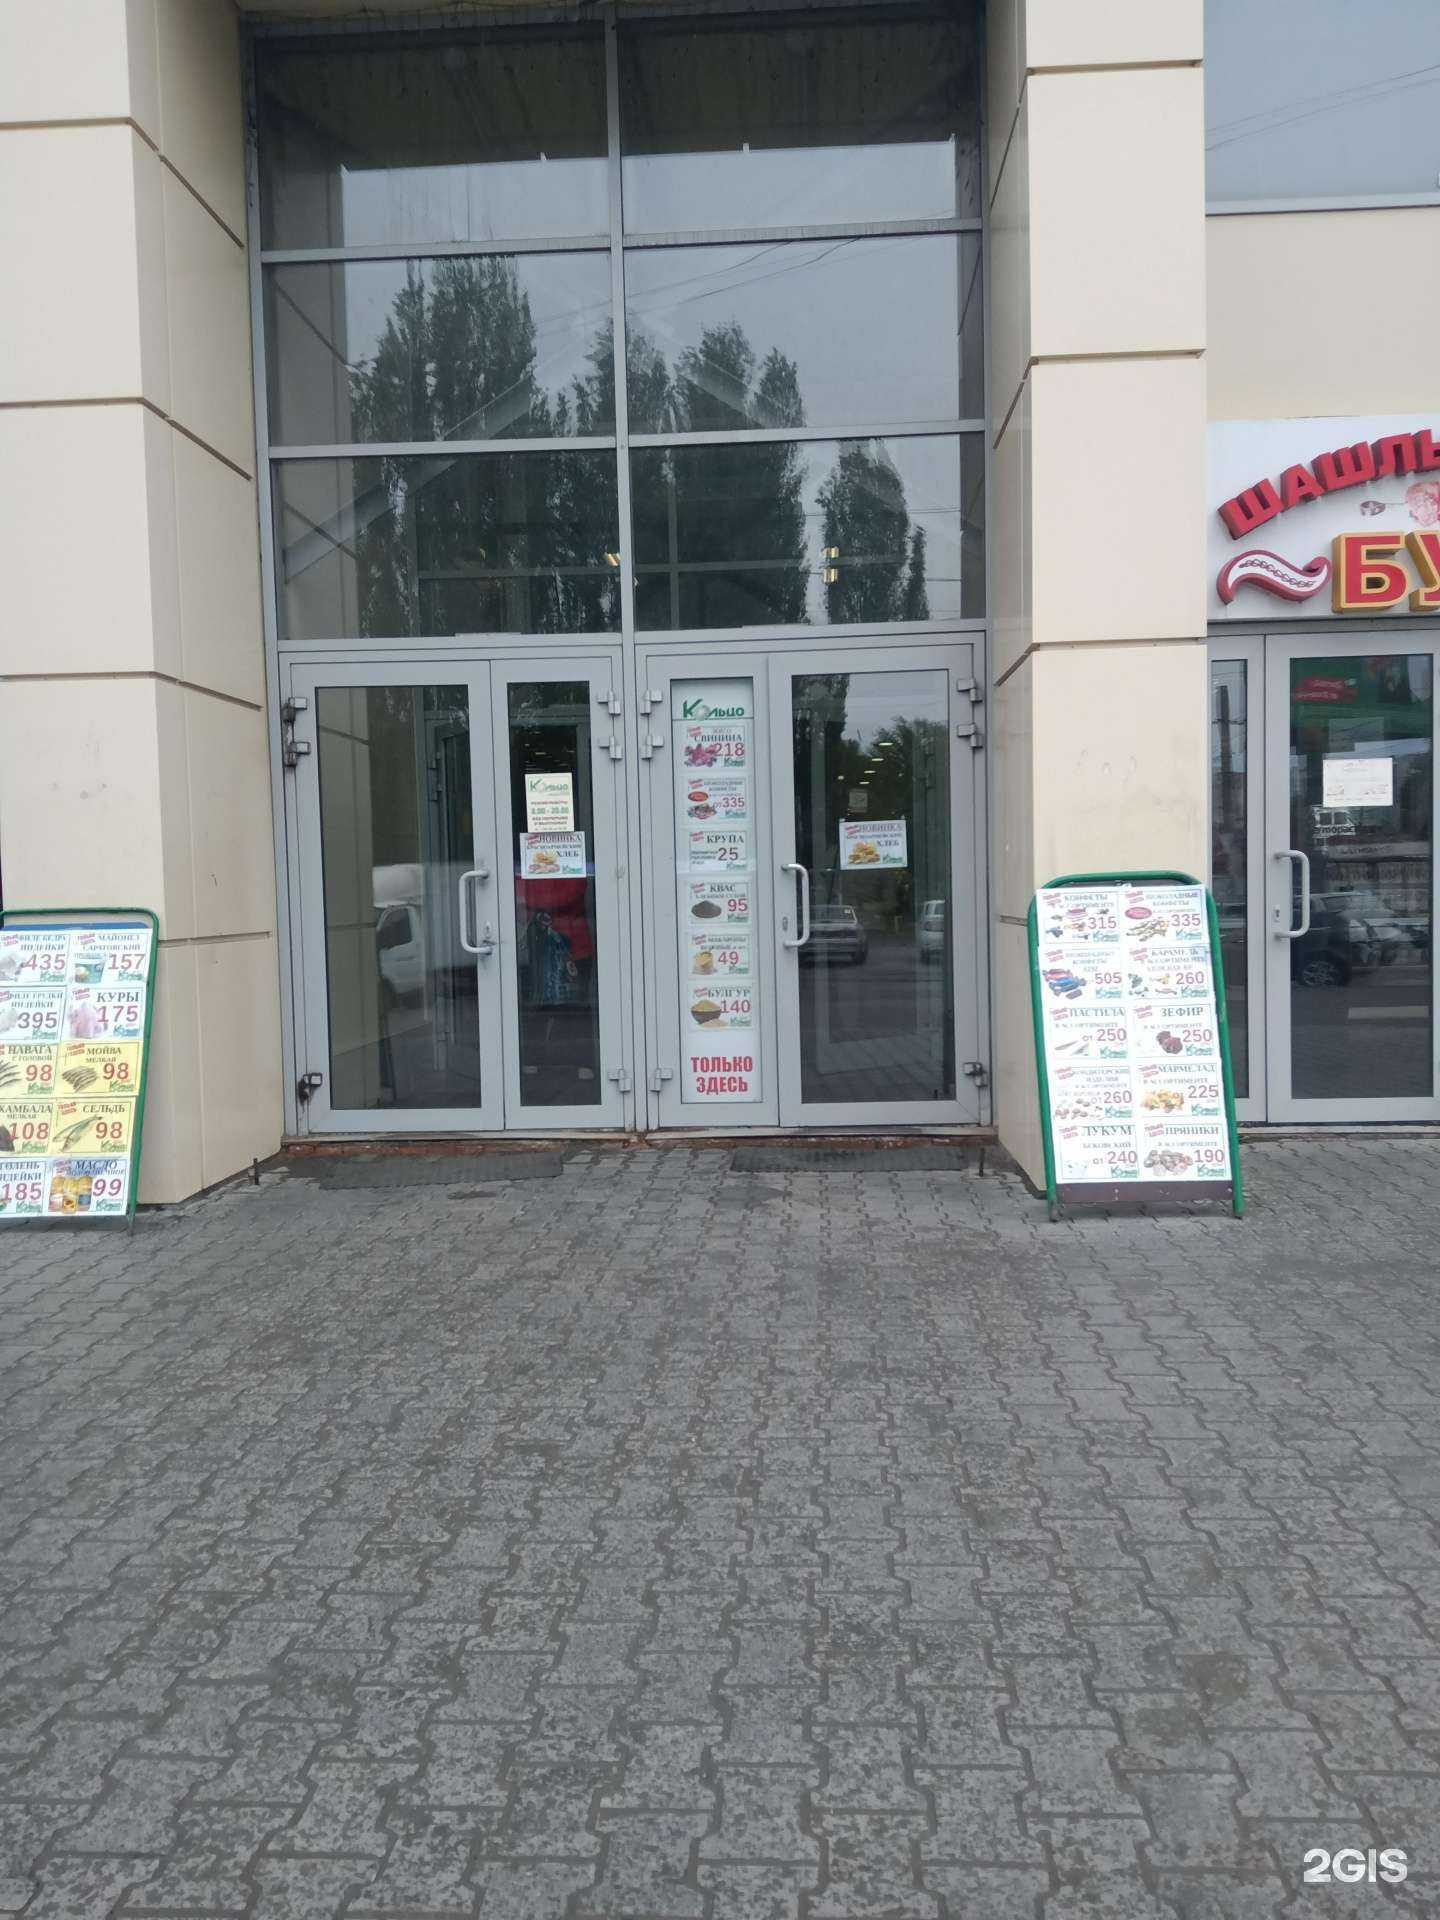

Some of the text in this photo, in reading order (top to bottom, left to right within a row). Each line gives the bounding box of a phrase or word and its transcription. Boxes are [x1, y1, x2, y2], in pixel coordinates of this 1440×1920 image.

[714, 743, 745, 757] 218
[722, 797, 745, 808] 335
[707, 835, 744, 844] КРУПА
[718, 847, 739, 861] 25
[727, 898, 748, 912] 95
[1088, 916, 1116, 929] 315
[1171, 914, 1200, 926] 335
[24, 954, 66, 971] 435
[108, 954, 145, 970] 157
[718, 951, 739, 965] 49
[1095, 972, 1122, 984] 505
[1176, 971, 1204, 984] 260
[97, 992, 140, 1003] КУРЫ
[708, 988, 750, 997] БУЛГУР
[720, 1000, 751, 1013] 140
[1161, 1007, 1203, 1017] ЗЕФИР
[18, 1012, 58, 1029] 395
[97, 1005, 139, 1023] 175
[1097, 1028, 1127, 1041] 250
[1183, 1029, 1213, 1042] 250
[8, 1044, 52, 1055] НАВАГА
[86, 1046, 122, 1055] МОЙВА
[103, 1062, 129, 1080] 98
[690, 1056, 753, 1073] ТОЛЬКО
[26, 1064, 52, 1081] 98
[696, 1076, 748, 1095] ЗДЕСЬ
[1188, 1085, 1219, 1099] 225
[1104, 1090, 1132, 1104] 260
[83, 1104, 125, 1113] СЕЛЬДЬ
[9, 1122, 49, 1141] 108
[96, 1121, 122, 1139] 98
[1082, 1126, 1132, 1136] ЛУКУМ
[1166, 1127, 1219, 1135] ПРЯНИКИ
[1107, 1151, 1137, 1164] 240
[1194, 1149, 1225, 1163] 190
[75, 1160, 117, 1169] МАСЛО
[2, 1182, 41, 1201] 185
[93, 1178, 121, 1196] 99
